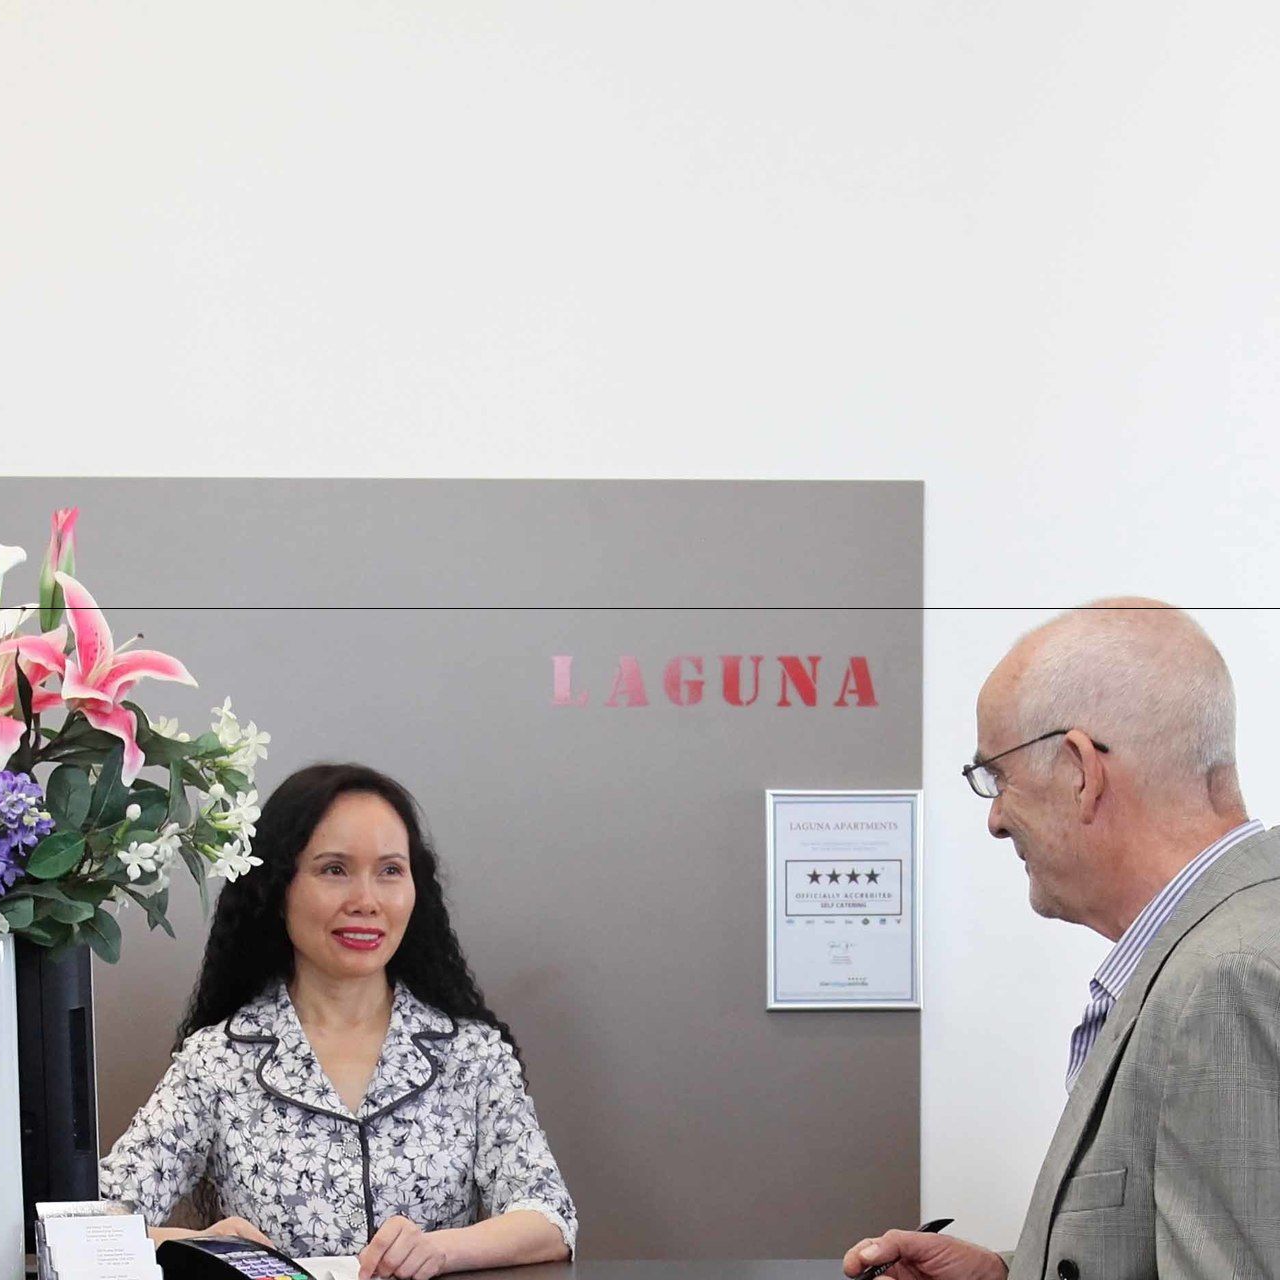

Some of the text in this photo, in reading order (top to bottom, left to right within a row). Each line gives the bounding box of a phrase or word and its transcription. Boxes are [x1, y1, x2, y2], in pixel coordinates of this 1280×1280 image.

[551, 655, 879, 708] LAGUNA
[789, 821, 898, 832] LAGUNA APARTMENTS
